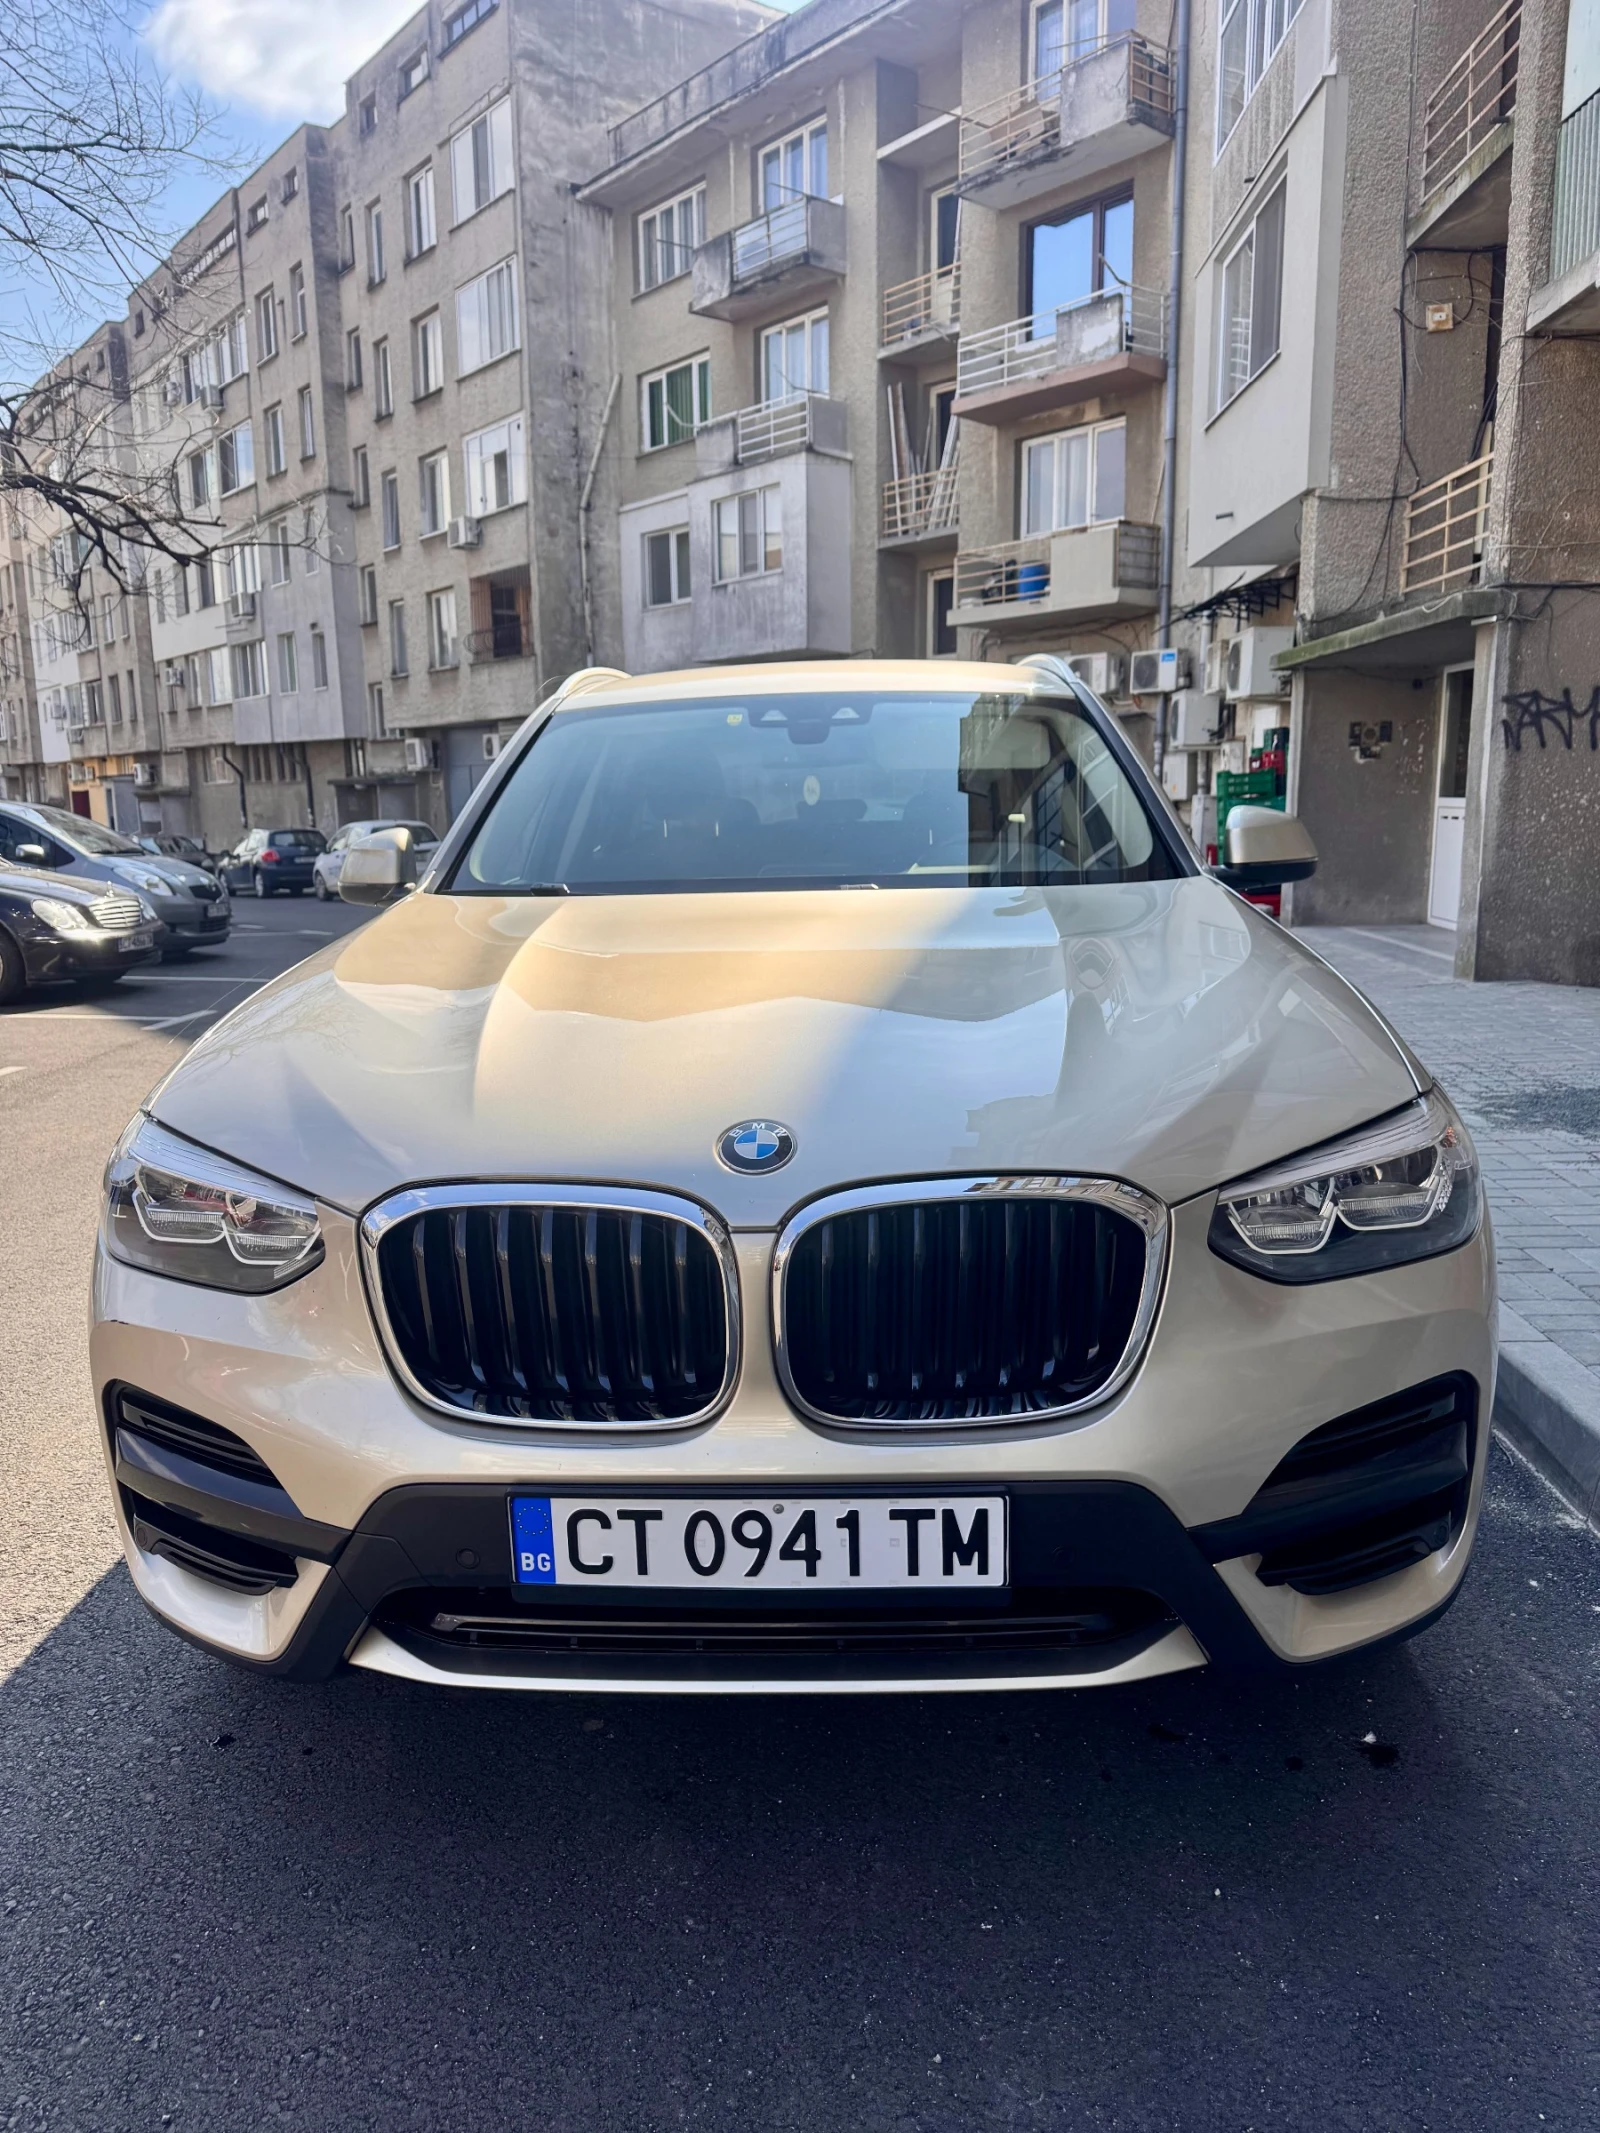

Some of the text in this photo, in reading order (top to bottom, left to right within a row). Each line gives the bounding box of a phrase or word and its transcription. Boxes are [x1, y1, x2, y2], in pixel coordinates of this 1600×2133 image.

[728, 1122, 788, 1138] BMW
[566, 1508, 989, 1577] CT 0941 TM
[520, 1552, 551, 1572] BG
